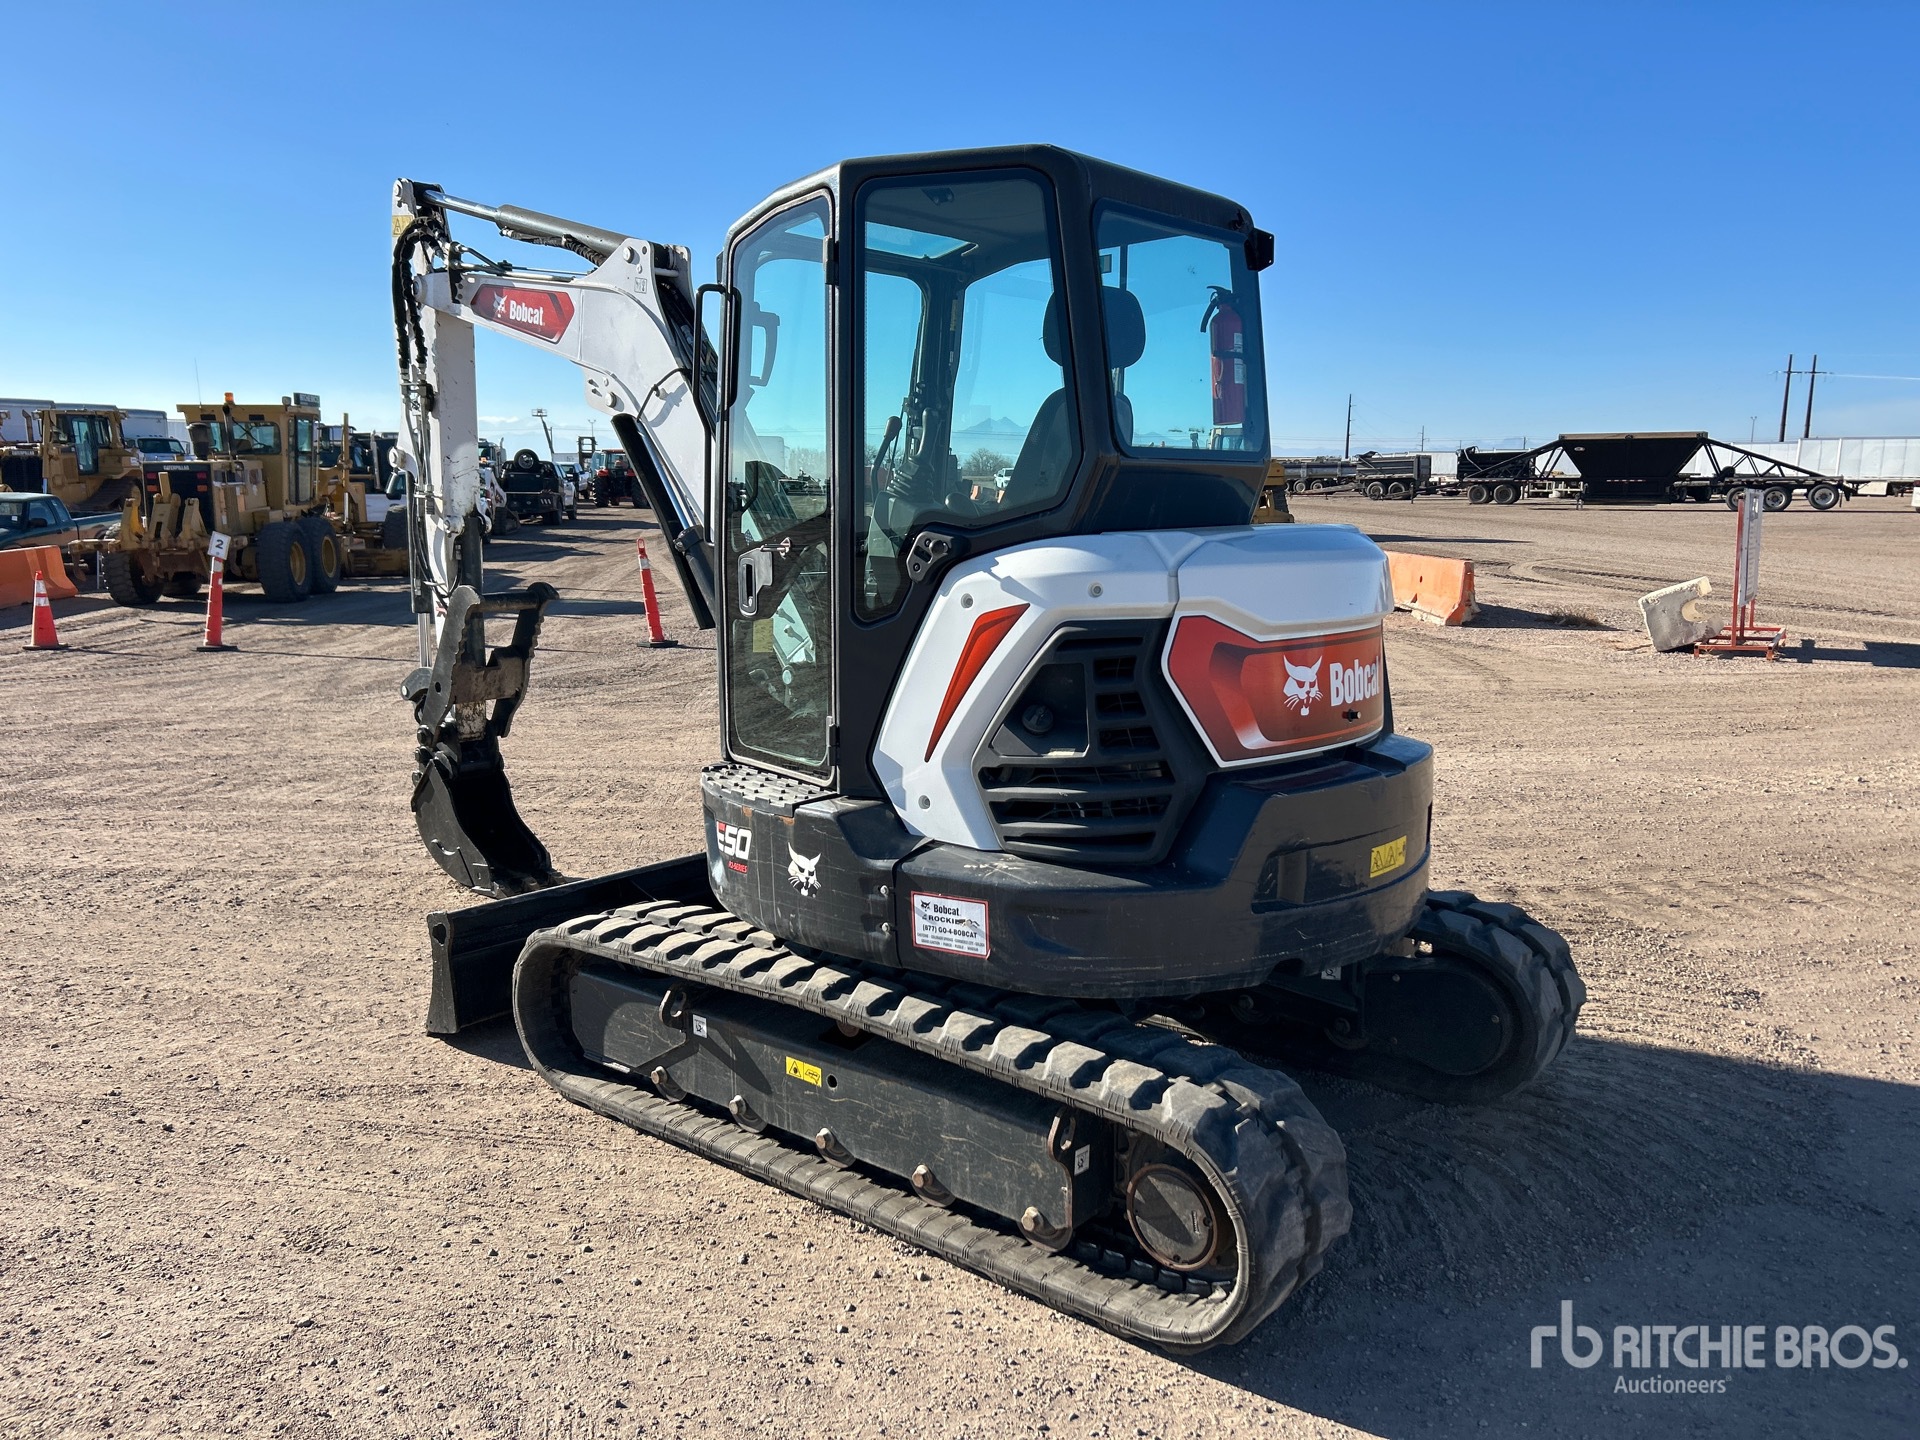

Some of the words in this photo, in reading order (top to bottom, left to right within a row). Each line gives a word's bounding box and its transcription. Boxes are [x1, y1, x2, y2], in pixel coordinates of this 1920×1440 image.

[510, 300, 544, 326] Bobcat
[215, 539, 224, 549] 2
[716, 820, 752, 860] E50
[933, 904, 960, 916] Bobcat
[928, 915, 966, 925] ROCKIE
